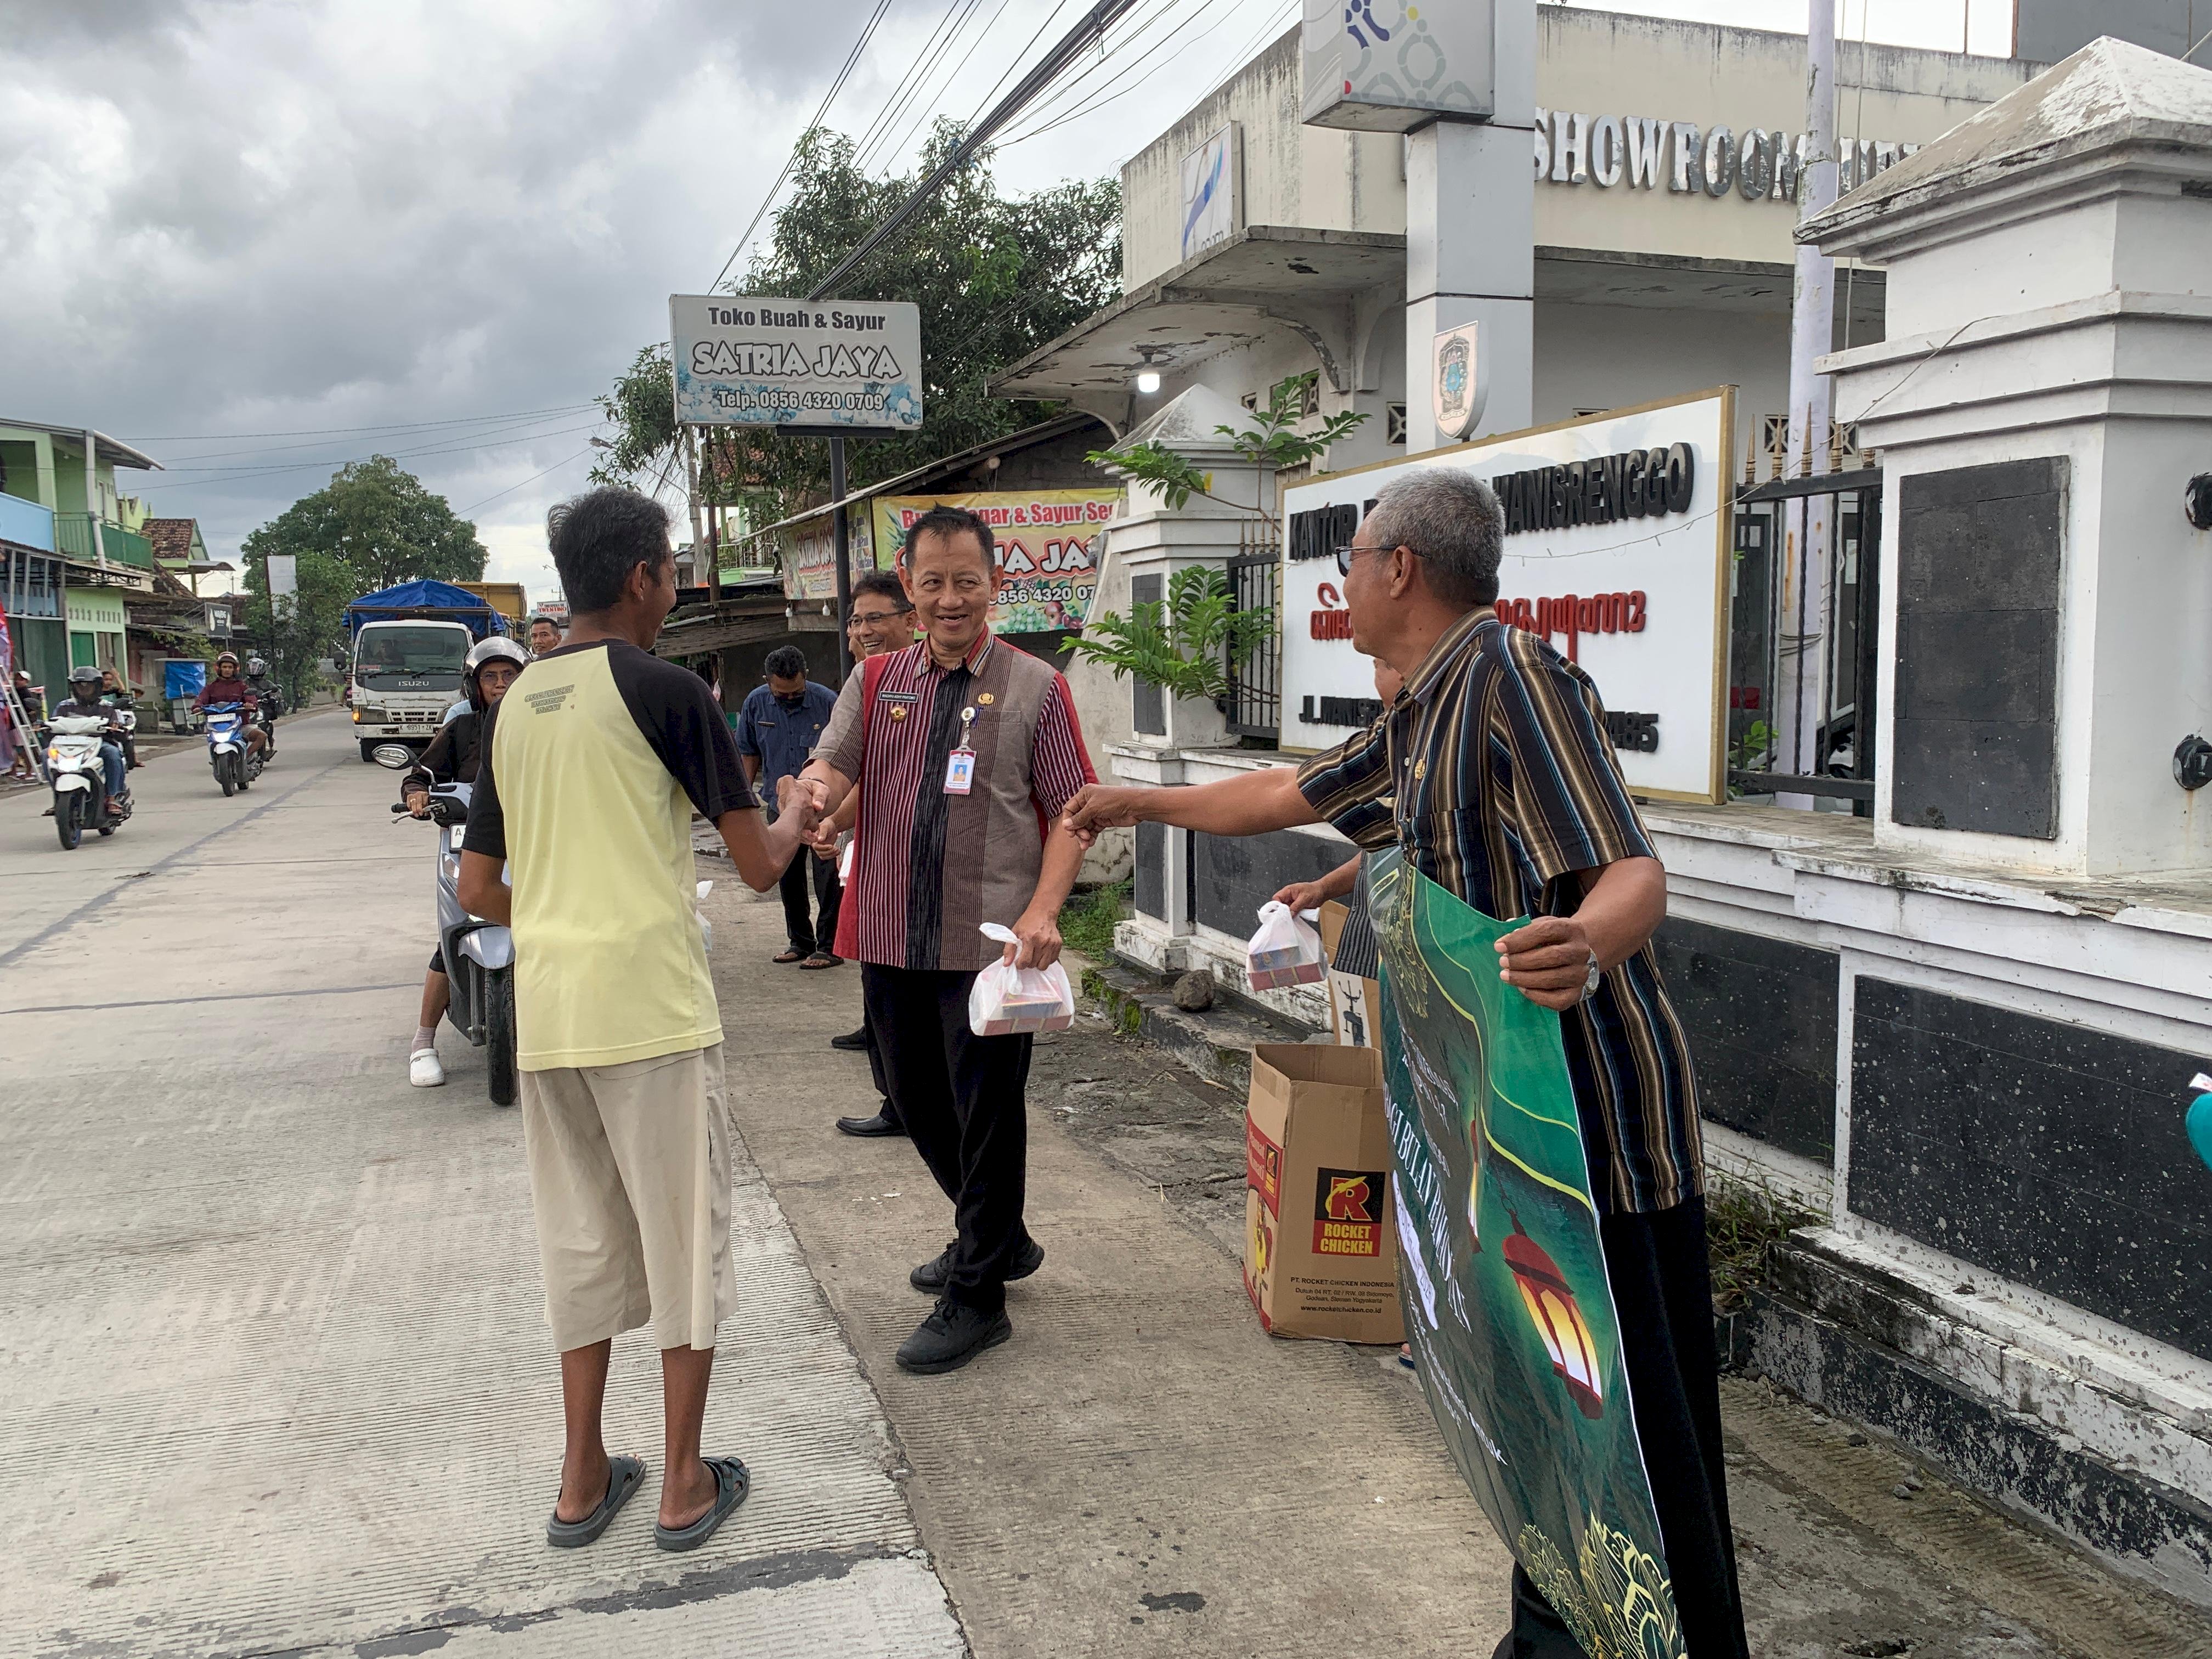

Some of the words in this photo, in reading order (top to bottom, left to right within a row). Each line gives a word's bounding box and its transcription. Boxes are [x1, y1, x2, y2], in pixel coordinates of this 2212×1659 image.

[708, 307, 755, 326] Toko
[761, 309, 809, 328] Buah
[814, 313, 827, 328] &
[832, 311, 885, 331] Sayur
[692, 340, 810, 377] SATRIA
[812, 343, 902, 379] JAYA
[718, 391, 755, 411] Telp.
[759, 392, 799, 409] 0856
[802, 392, 842, 410] 4320
[846, 393, 884, 411] 0709
[1289, 504, 1358, 561] KANTOR
[1492, 442, 1694, 534] MANISRENGGO
[1014, 507, 1026, 523] &
[1030, 504, 1082, 528] Sayur
[1041, 540, 1090, 572] JA
[990, 589, 1029, 606] 856
[1032, 586, 1073, 602] 4320
[1076, 585, 1096, 600] 07
[455, 827, 462, 837] A
[1398, 1120, 1436, 1206] BULAN
[1324, 1223, 1371, 1239] ROCKET
[1321, 1238, 1373, 1254] CHICKEN
[1301, 1306, 1381, 1314] www.rocketchicken.co.id
